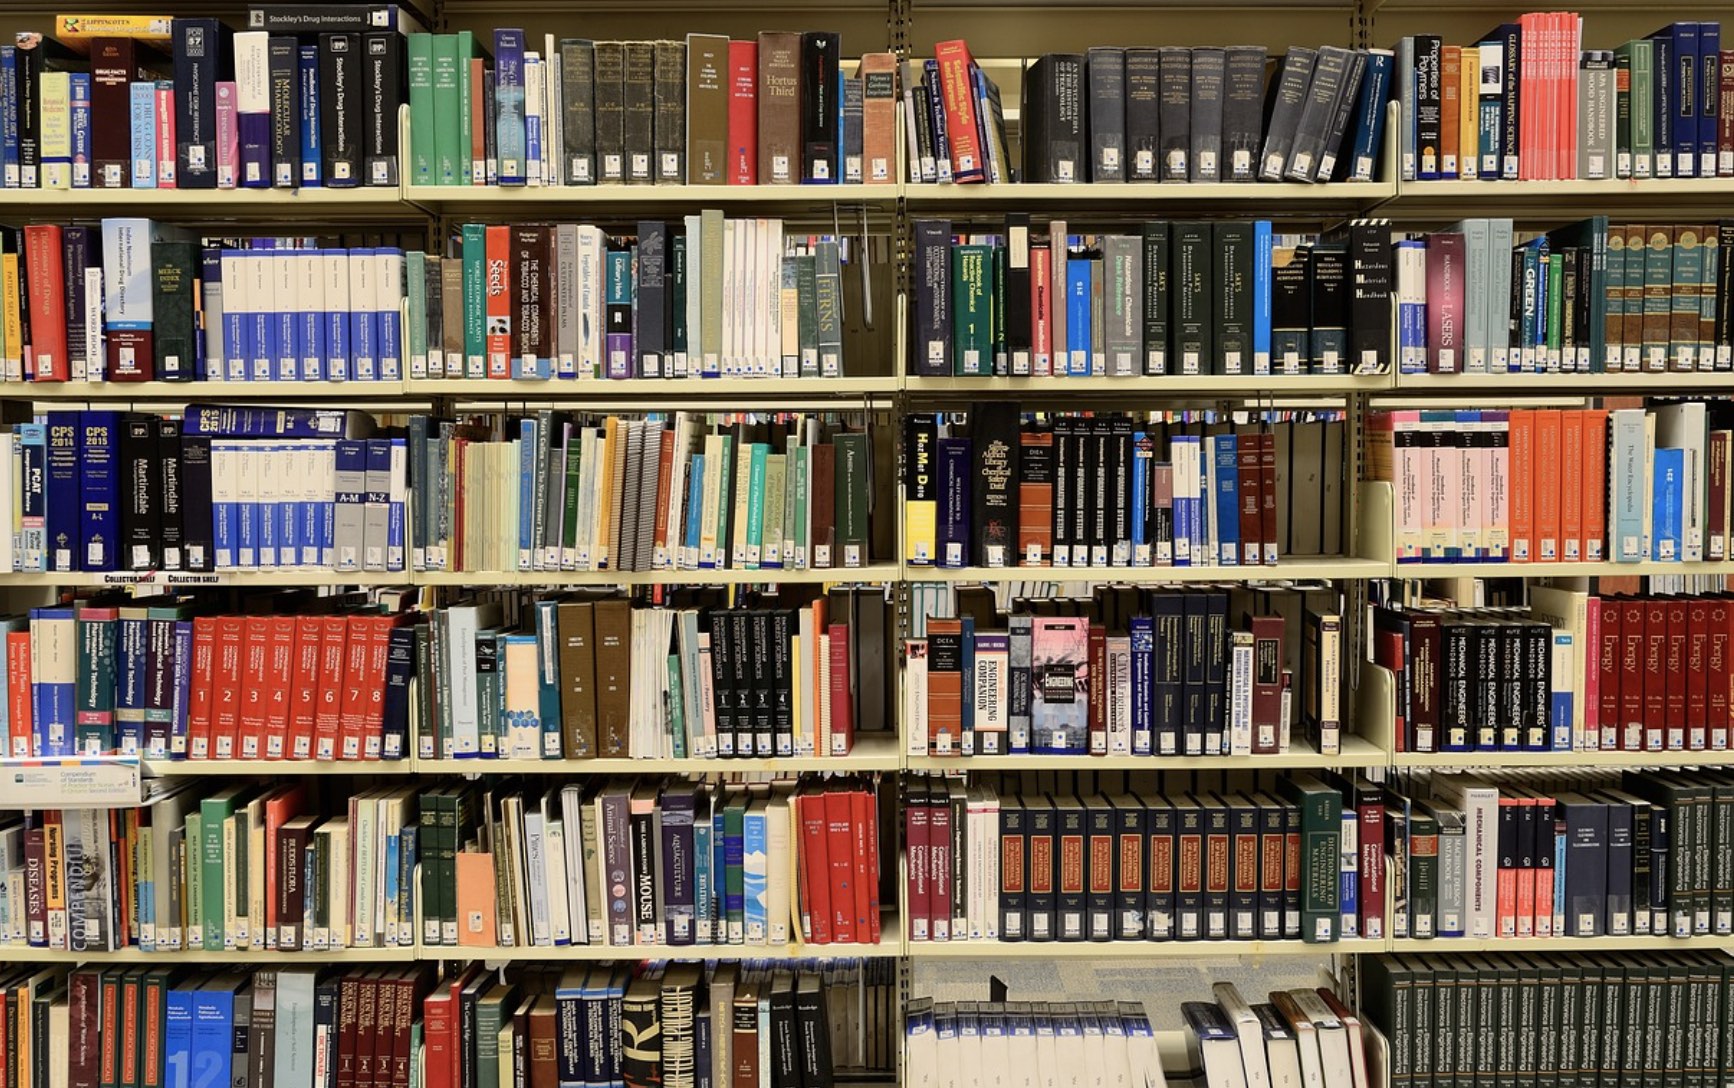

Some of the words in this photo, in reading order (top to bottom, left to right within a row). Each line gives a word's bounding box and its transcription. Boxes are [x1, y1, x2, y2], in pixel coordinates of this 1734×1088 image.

[269, 15, 302, 24] Stockley's
[303, 15, 320, 24] Drug
[320, 15, 361, 23] Interactions
[1428, 39, 1440, 87] Properties
[1507, 33, 1517, 72] GLOSSARY
[335, 57, 344, 92] Stockley's
[373, 60, 382, 94] Stockley's
[766, 75, 797, 86] Hortus
[769, 85, 795, 97] Third
[953, 59, 968, 101] Scientific
[1417, 54, 1429, 100] Polymers
[1587, 72, 1596, 98] WOOD
[1598, 72, 1606, 88] APA
[282, 78, 291, 137] MOLECULAR
[336, 92, 345, 110] Drug
[374, 94, 383, 113] Drug
[1430, 88, 1440, 100] of
[1506, 91, 1517, 124] MAPPING
[274, 79, 283, 155] PHARMACOLOGY
[337, 110, 345, 152] Interactions
[960, 101, 970, 125] Style
[1587, 100, 1596, 146] HANDBOOK
[1598, 89, 1606, 139] ENGINEERED
[375, 113, 383, 155] Interactions
[118, 226, 126, 269] International
[530, 259, 539, 271] THE
[1115, 255, 1123, 276] Desk
[1354, 260, 1388, 270] Hazardous
[117, 269, 125, 285] Drug
[490, 259, 504, 296] Seeds
[521, 260, 529, 288] TOBACCO
[530, 272, 539, 303] CHEMICAL
[560, 261, 568, 304] CULTIVATED
[614, 257, 623, 282] Culinary
[1124, 255, 1133, 295] Hazardous
[1355, 274, 1387, 285] Materials
[117, 286, 126, 315] Directory
[521, 289, 529, 303] AND
[818, 278, 834, 332] FERNS
[1115, 276, 1123, 316] Reference
[1355, 288, 1387, 299] Handbook
[1524, 268, 1535, 316] GREEN
[7, 300, 15, 338] SELF-CARE
[521, 304, 529, 331] TOBACCO
[530, 304, 539, 346] COMPONENTS
[560, 306, 568, 329] PALMS
[1124, 296, 1133, 337] Chemicals
[1441, 303, 1453, 346] LASERS
[51, 426, 74, 437] CPS
[86, 426, 108, 437] CPS
[200, 410, 210, 432] CPS
[209, 409, 219, 432] 2015
[51, 438, 74, 447] 2014
[86, 437, 108, 445] 2015
[982, 451, 1006, 459] Aldrich
[981, 466, 1012, 476] Chemical
[984, 458, 1008, 467] Library
[988, 475, 1008, 485] Safety
[31, 468, 41, 494] PCAT
[137, 458, 149, 514] Martindale
[167, 457, 178, 514] Martindale
[339, 493, 359, 503] A-M
[368, 493, 386, 502] N-Z
[989, 482, 1006, 490] Data
[1056, 467, 1065, 509] INFORMATION
[1076, 467, 1084, 509] INFORMATION
[1096, 466, 1105, 509] INFORMATION
[1116, 466, 1124, 508] INFORMATION
[1626, 474, 1634, 513] Encyclopedia
[1056, 510, 1065, 539] SYSTEMS
[1076, 510, 1084, 540] SYSTEMS
[1096, 509, 1105, 539] SYSTEMS
[104, 575, 138, 583] COLLECTOR
[168, 575, 201, 583] COLLECTOR
[202, 575, 219, 583] SHELF
[90, 623, 99, 671] Pharmaceutical
[126, 622, 135, 670] Pharmaceutical
[154, 622, 164, 670] Pharmaceutical
[1458, 636, 1467, 678] MECHANICAL
[1488, 638, 1496, 679] MECHANICAL
[1513, 638, 1521, 679] MECHANICAL
[1537, 638, 1546, 679] MECHANICAL
[1602, 635, 1619, 674] Energy
[1625, 635, 1642, 674] Energy
[1648, 635, 1665, 674] Energy
[1668, 635, 1686, 674] Energy
[1690, 634, 1707, 673] Energy
[1710, 633, 1727, 672] Energy
[977, 659, 987, 710] COMPANION
[1117, 652, 1128, 685] CIVIL
[89, 672, 98, 708] Technology
[126, 670, 134, 706] Technology
[154, 670, 163, 706] Technology
[199, 691, 205, 701] 1
[223, 691, 232, 702] 2
[250, 691, 258, 702] 3
[274, 691, 282, 702] 4
[302, 691, 310, 702] 5
[325, 691, 334, 703] 6
[351, 690, 359, 701] 7
[372, 690, 381, 702] 8
[987, 660, 998, 722] ENGINEERING
[605, 803, 616, 834] Animal
[1475, 807, 1483, 857] MECHANICAL
[1676, 806, 1685, 846] Electronics
[1695, 805, 1703, 844] Electronics
[1717, 805, 1726, 844] Electronics
[48, 827, 58, 858] Nursing
[529, 833, 540, 860] Pines
[607, 835, 618, 865] Science
[1444, 838, 1452, 881] DATABOOK
[1453, 838, 1461, 875] MACHINE
[50, 859, 59, 900] Programs
[288, 865, 296, 893] FLORA
[672, 833, 682, 898] AQUACULTURE
[909, 845, 917, 880] Mechanics
[917, 845, 925, 895] Computational
[930, 845, 938, 881] Mechanics
[937, 845, 946, 895] Computational
[1319, 841, 1327, 902] ENGINEERING
[1327, 836, 1335, 893] DICTIONARY
[1676, 847, 1685, 892] Engineering
[1694, 845, 1703, 890] Engineering
[1716, 845, 1726, 890] Engineering
[27, 858, 39, 915] DISEASES
[639, 874, 653, 920] MOUSE
[1327, 894, 1334, 906] OF
[1453, 877, 1461, 907] DESIGN
[1474, 859, 1483, 912] COMPONENTS
[169, 1050, 188, 1088] 1
[317, 1035, 325, 1077] DICTIONARY
